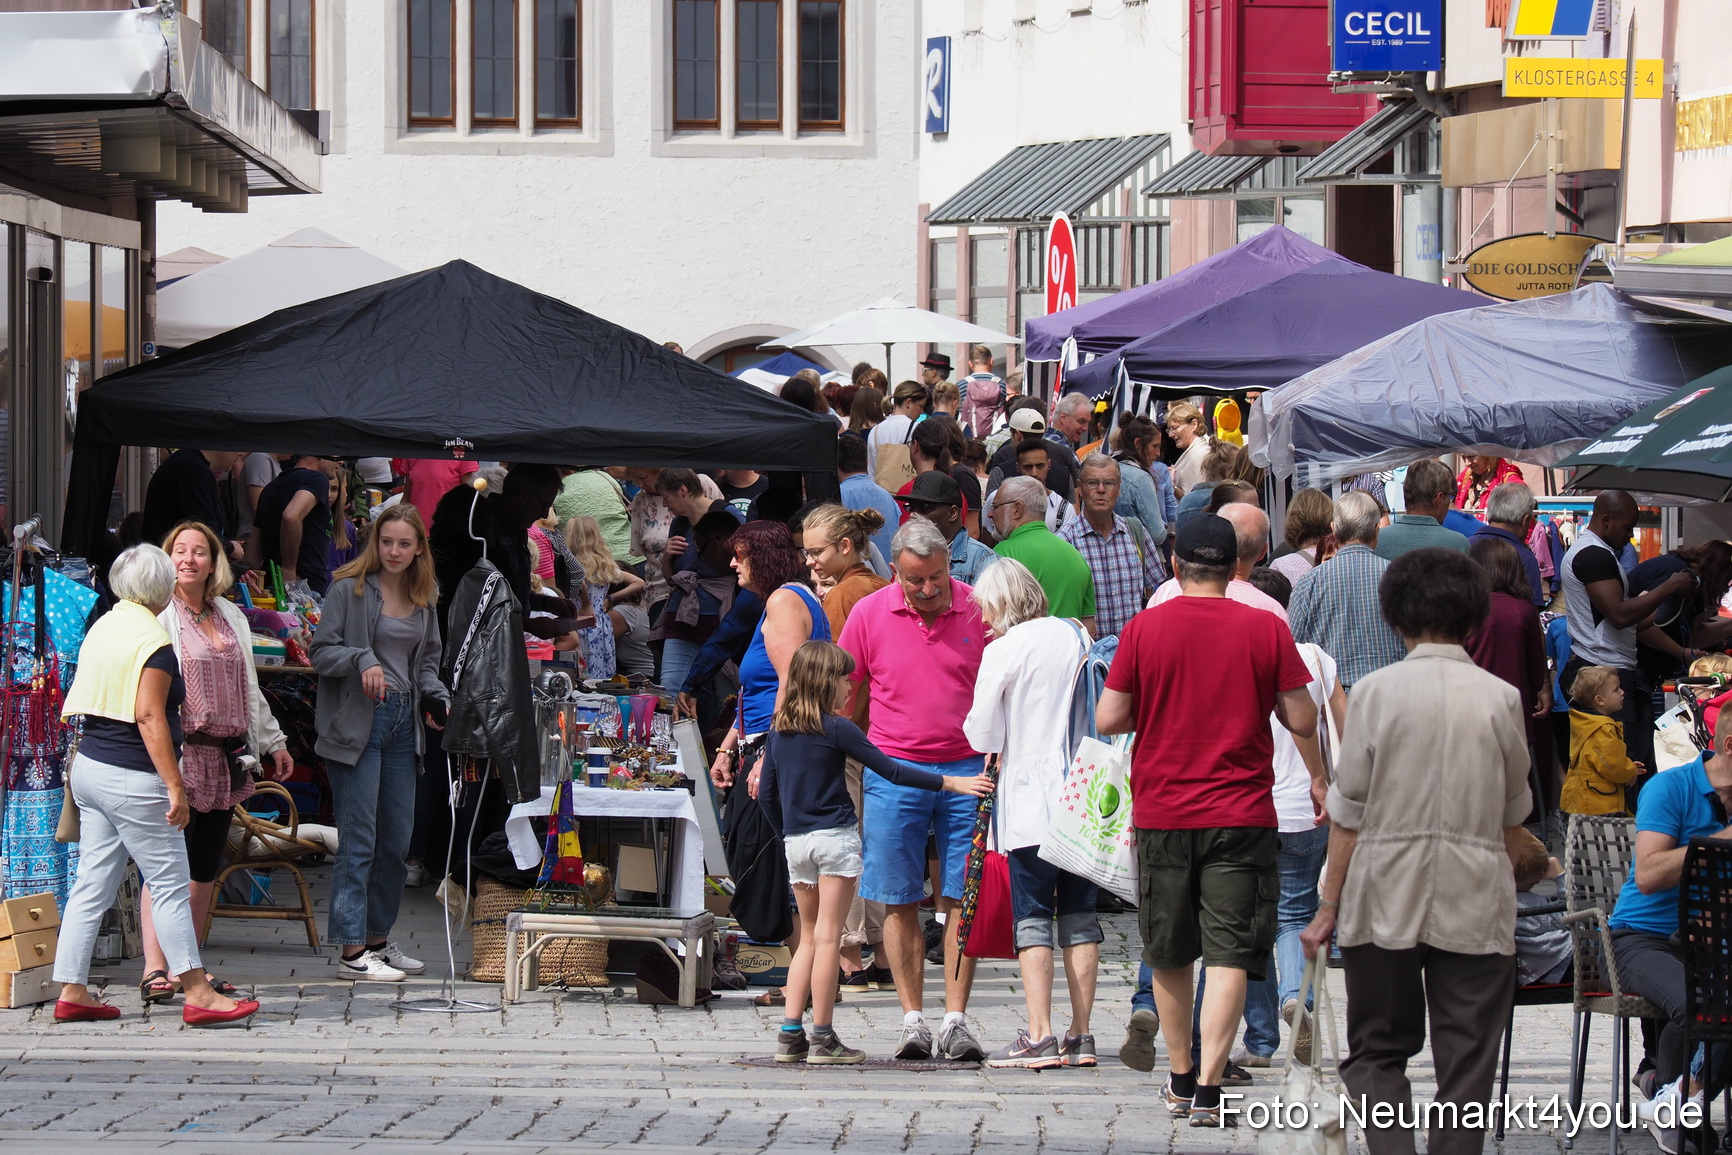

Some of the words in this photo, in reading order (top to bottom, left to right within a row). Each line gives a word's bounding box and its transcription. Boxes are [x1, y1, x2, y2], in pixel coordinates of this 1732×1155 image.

[1344, 11, 1431, 36] CECIL
[1646, 71, 1654, 87] 4
[1473, 262, 1500, 276] DIE
[1516, 282, 1547, 291] JUTTA
